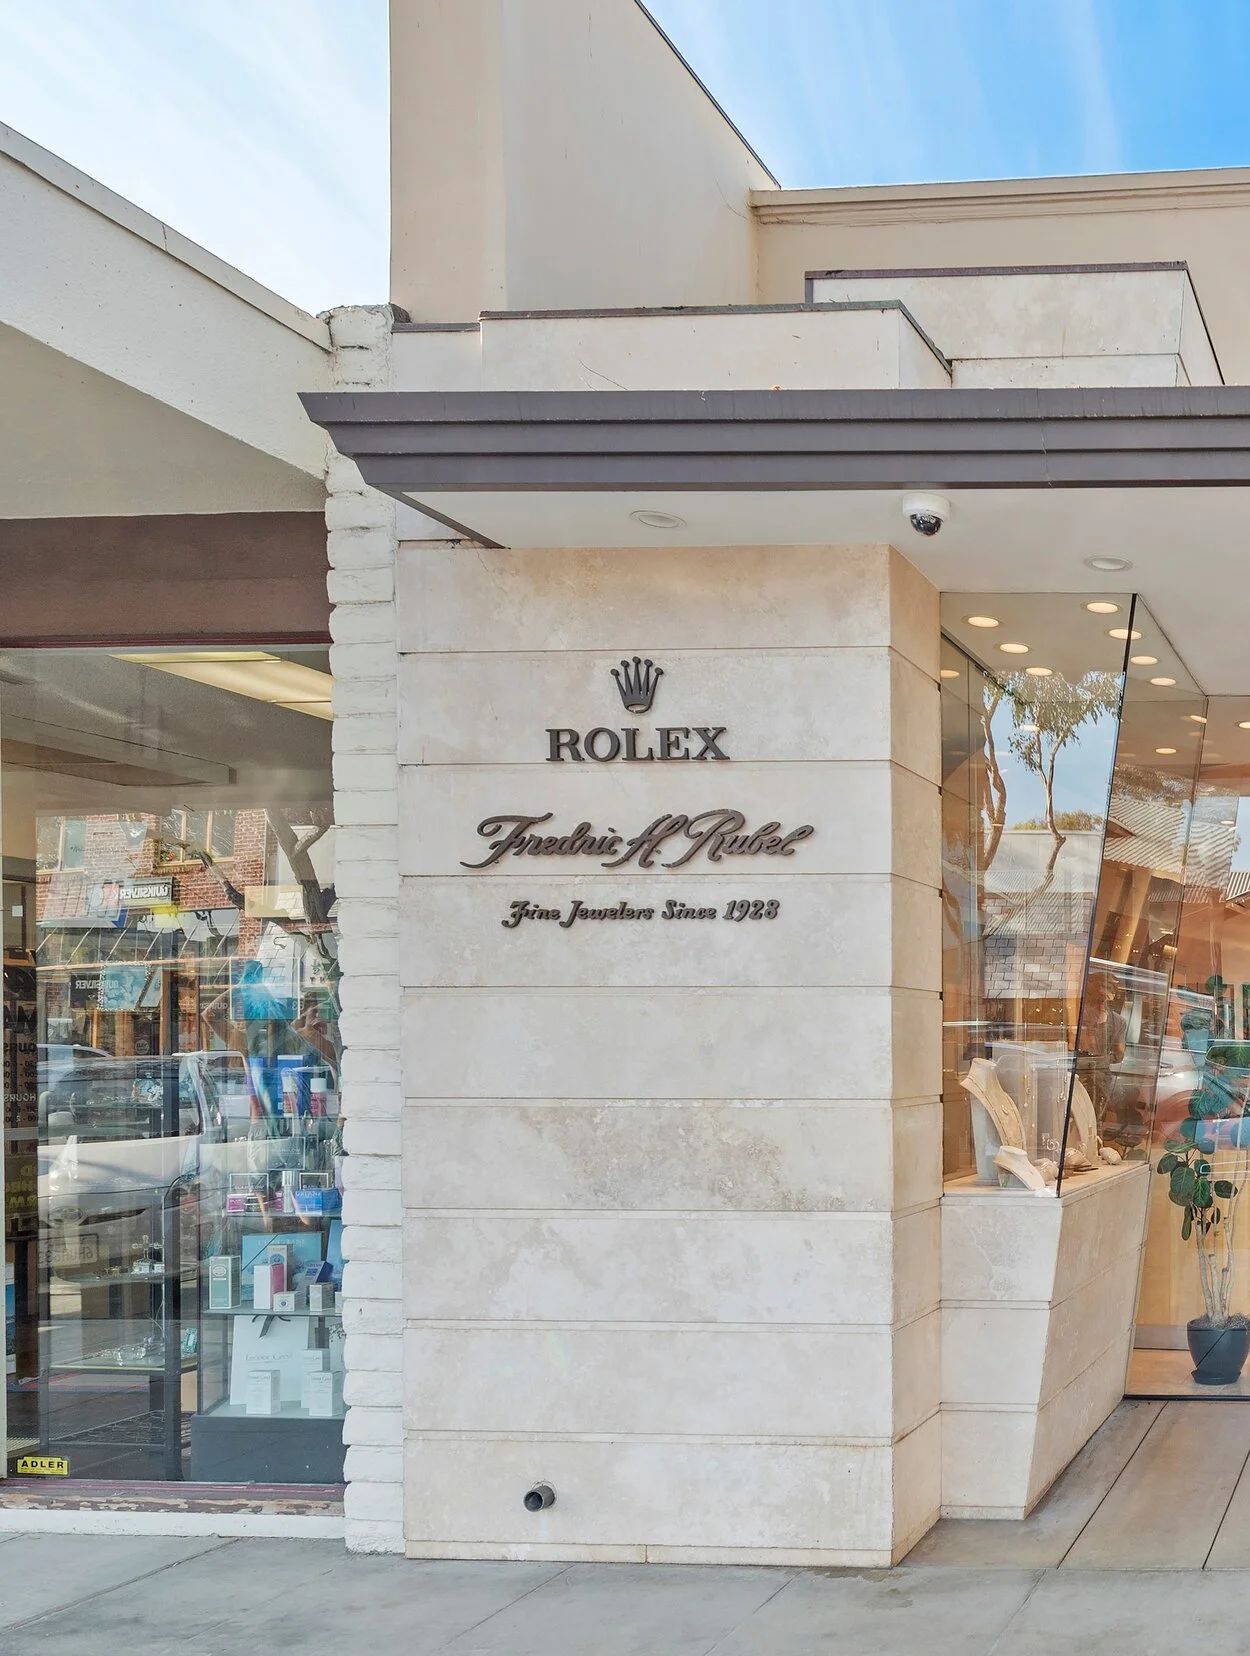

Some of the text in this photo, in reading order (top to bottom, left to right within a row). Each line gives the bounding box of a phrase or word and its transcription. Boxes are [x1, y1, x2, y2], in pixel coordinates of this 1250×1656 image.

[545, 726, 731, 762] ROLEX
[459, 811, 623, 869] Fredric
[661, 808, 815, 869] Rubel
[501, 899, 780, 928] Fine Jewelers Since 1928
[21, 1460, 64, 1469] ADLER
